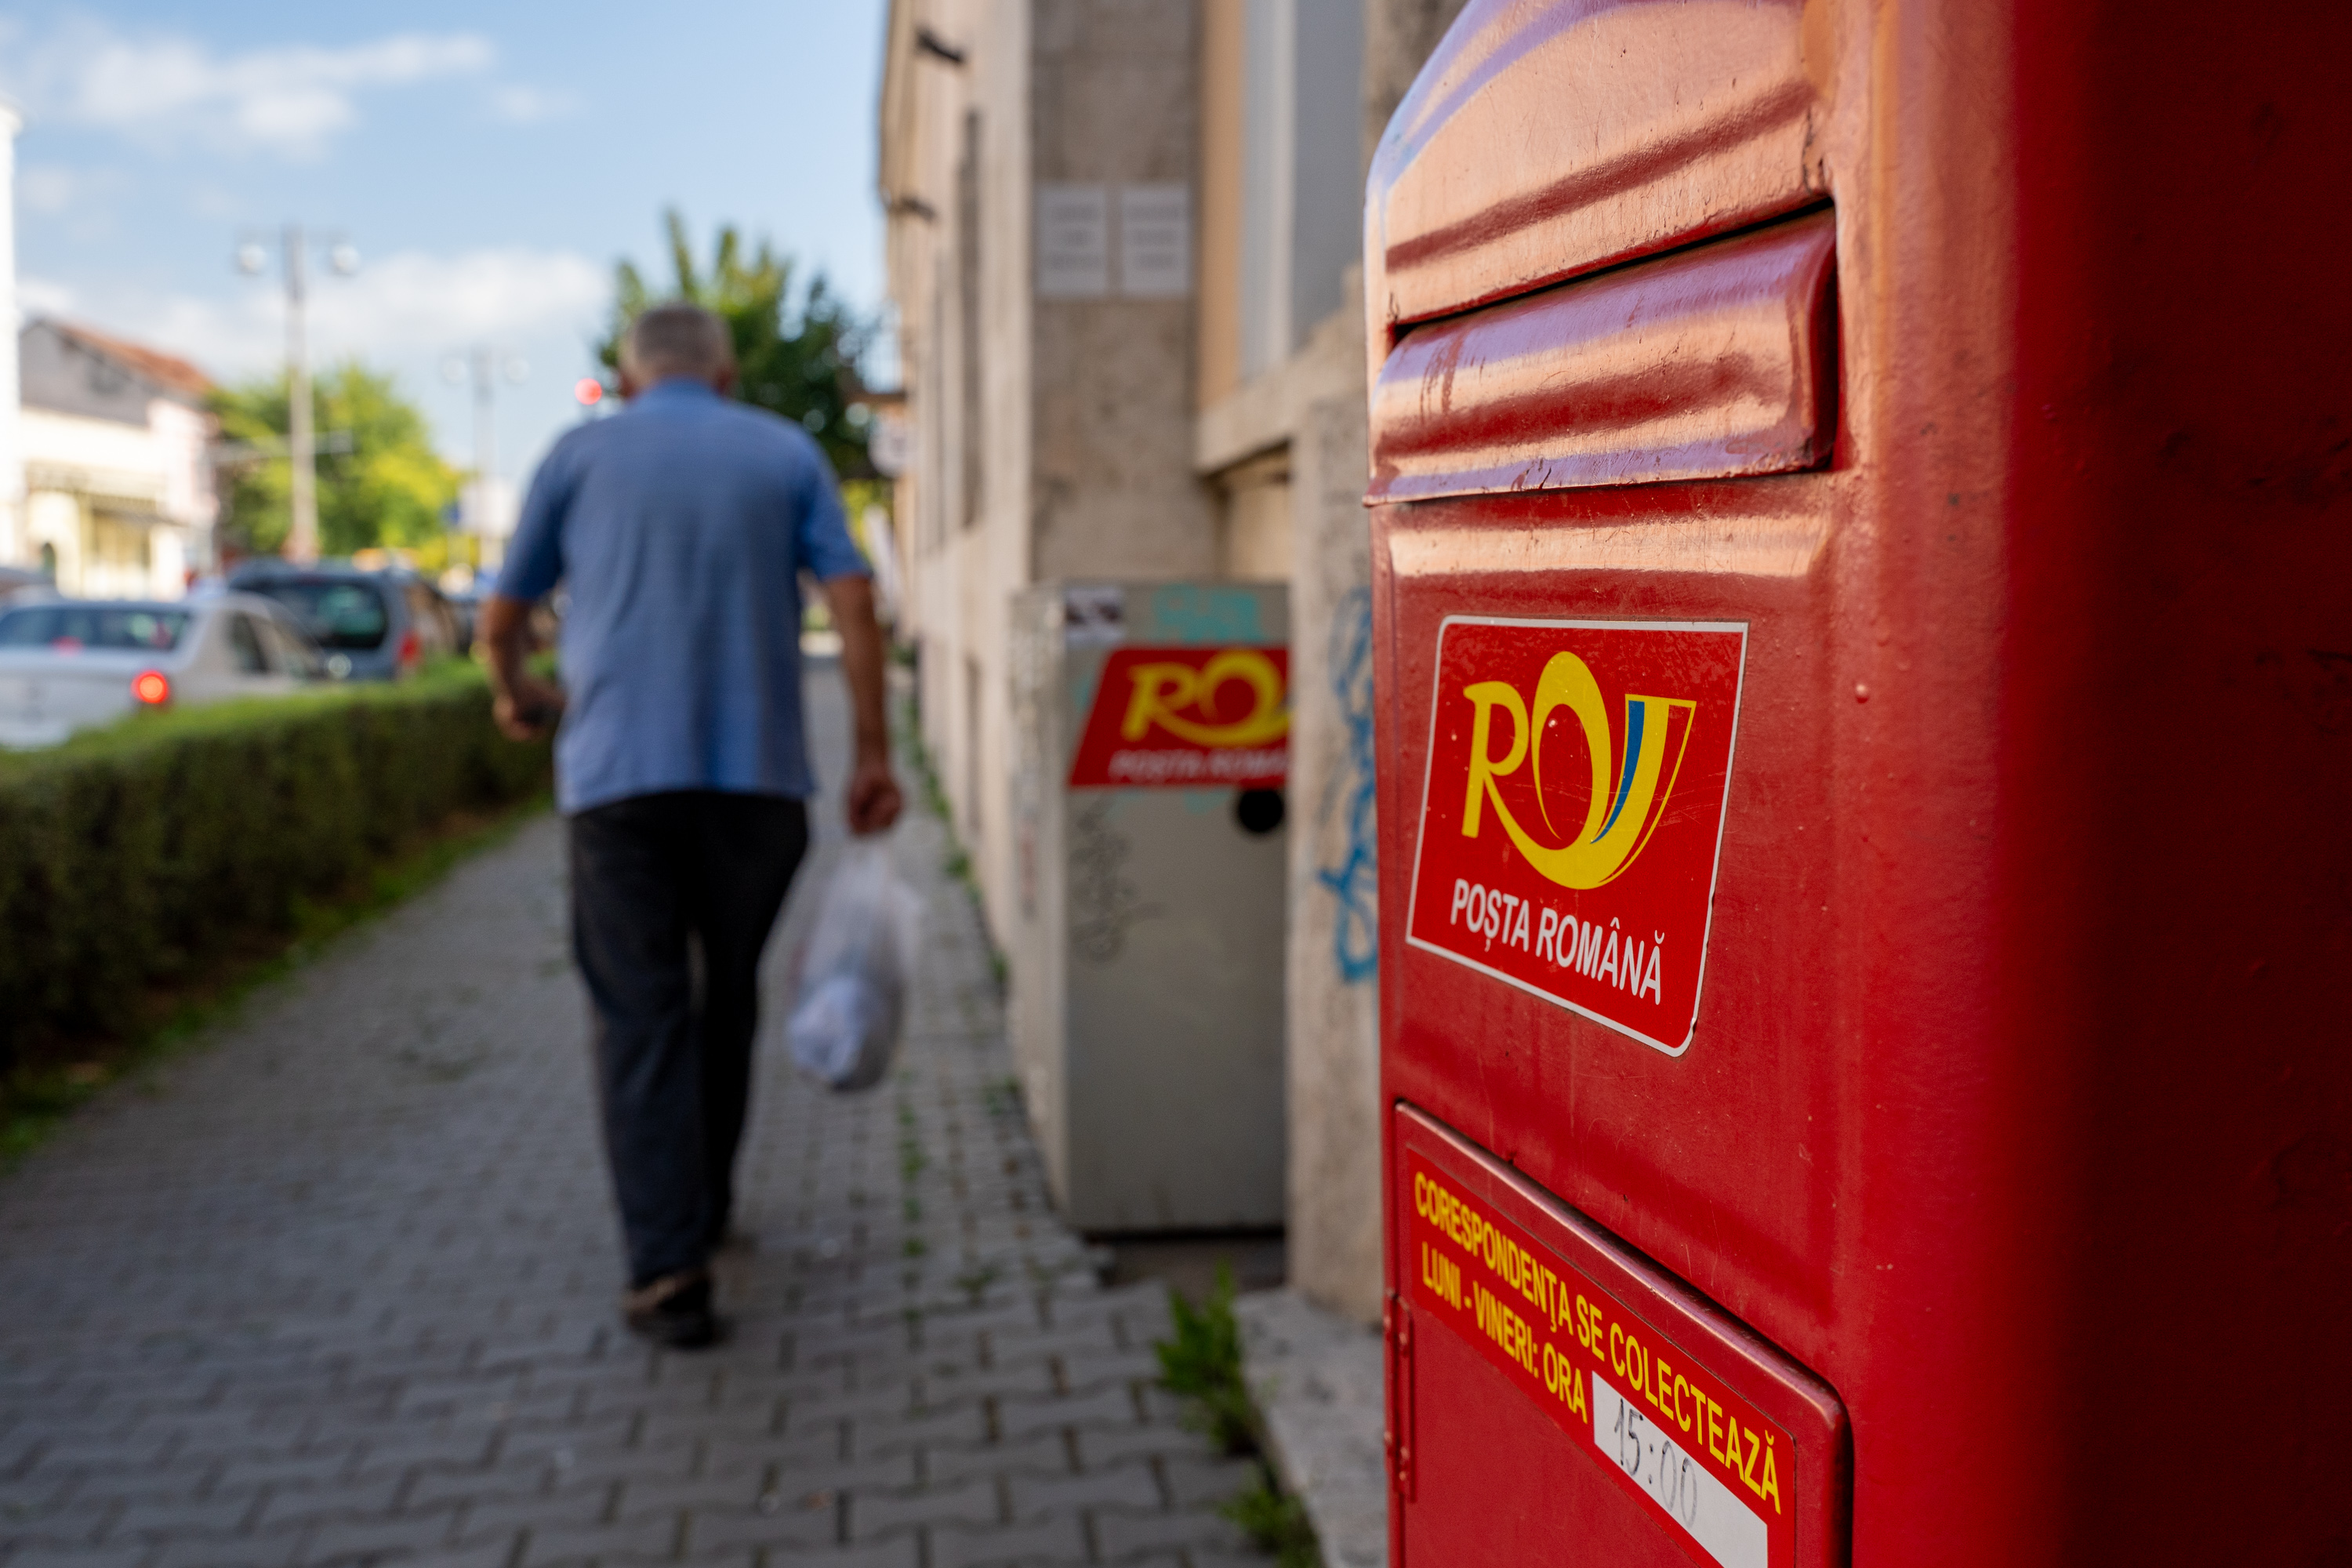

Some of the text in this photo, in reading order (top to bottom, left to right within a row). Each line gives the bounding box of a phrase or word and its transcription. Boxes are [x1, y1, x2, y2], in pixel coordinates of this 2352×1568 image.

[1535, 906, 1664, 1006] ROMÂNĂ
[1422, 1241, 1462, 1312] LUNI
[1472, 1280, 1540, 1379] VINERI:
[1543, 1342, 1588, 1425] ORA
[1576, 1294, 1605, 1363] SE
[1610, 1322, 1781, 1515] COLECTEAZĂ
[1614, 1398, 1697, 1530] 15:00
